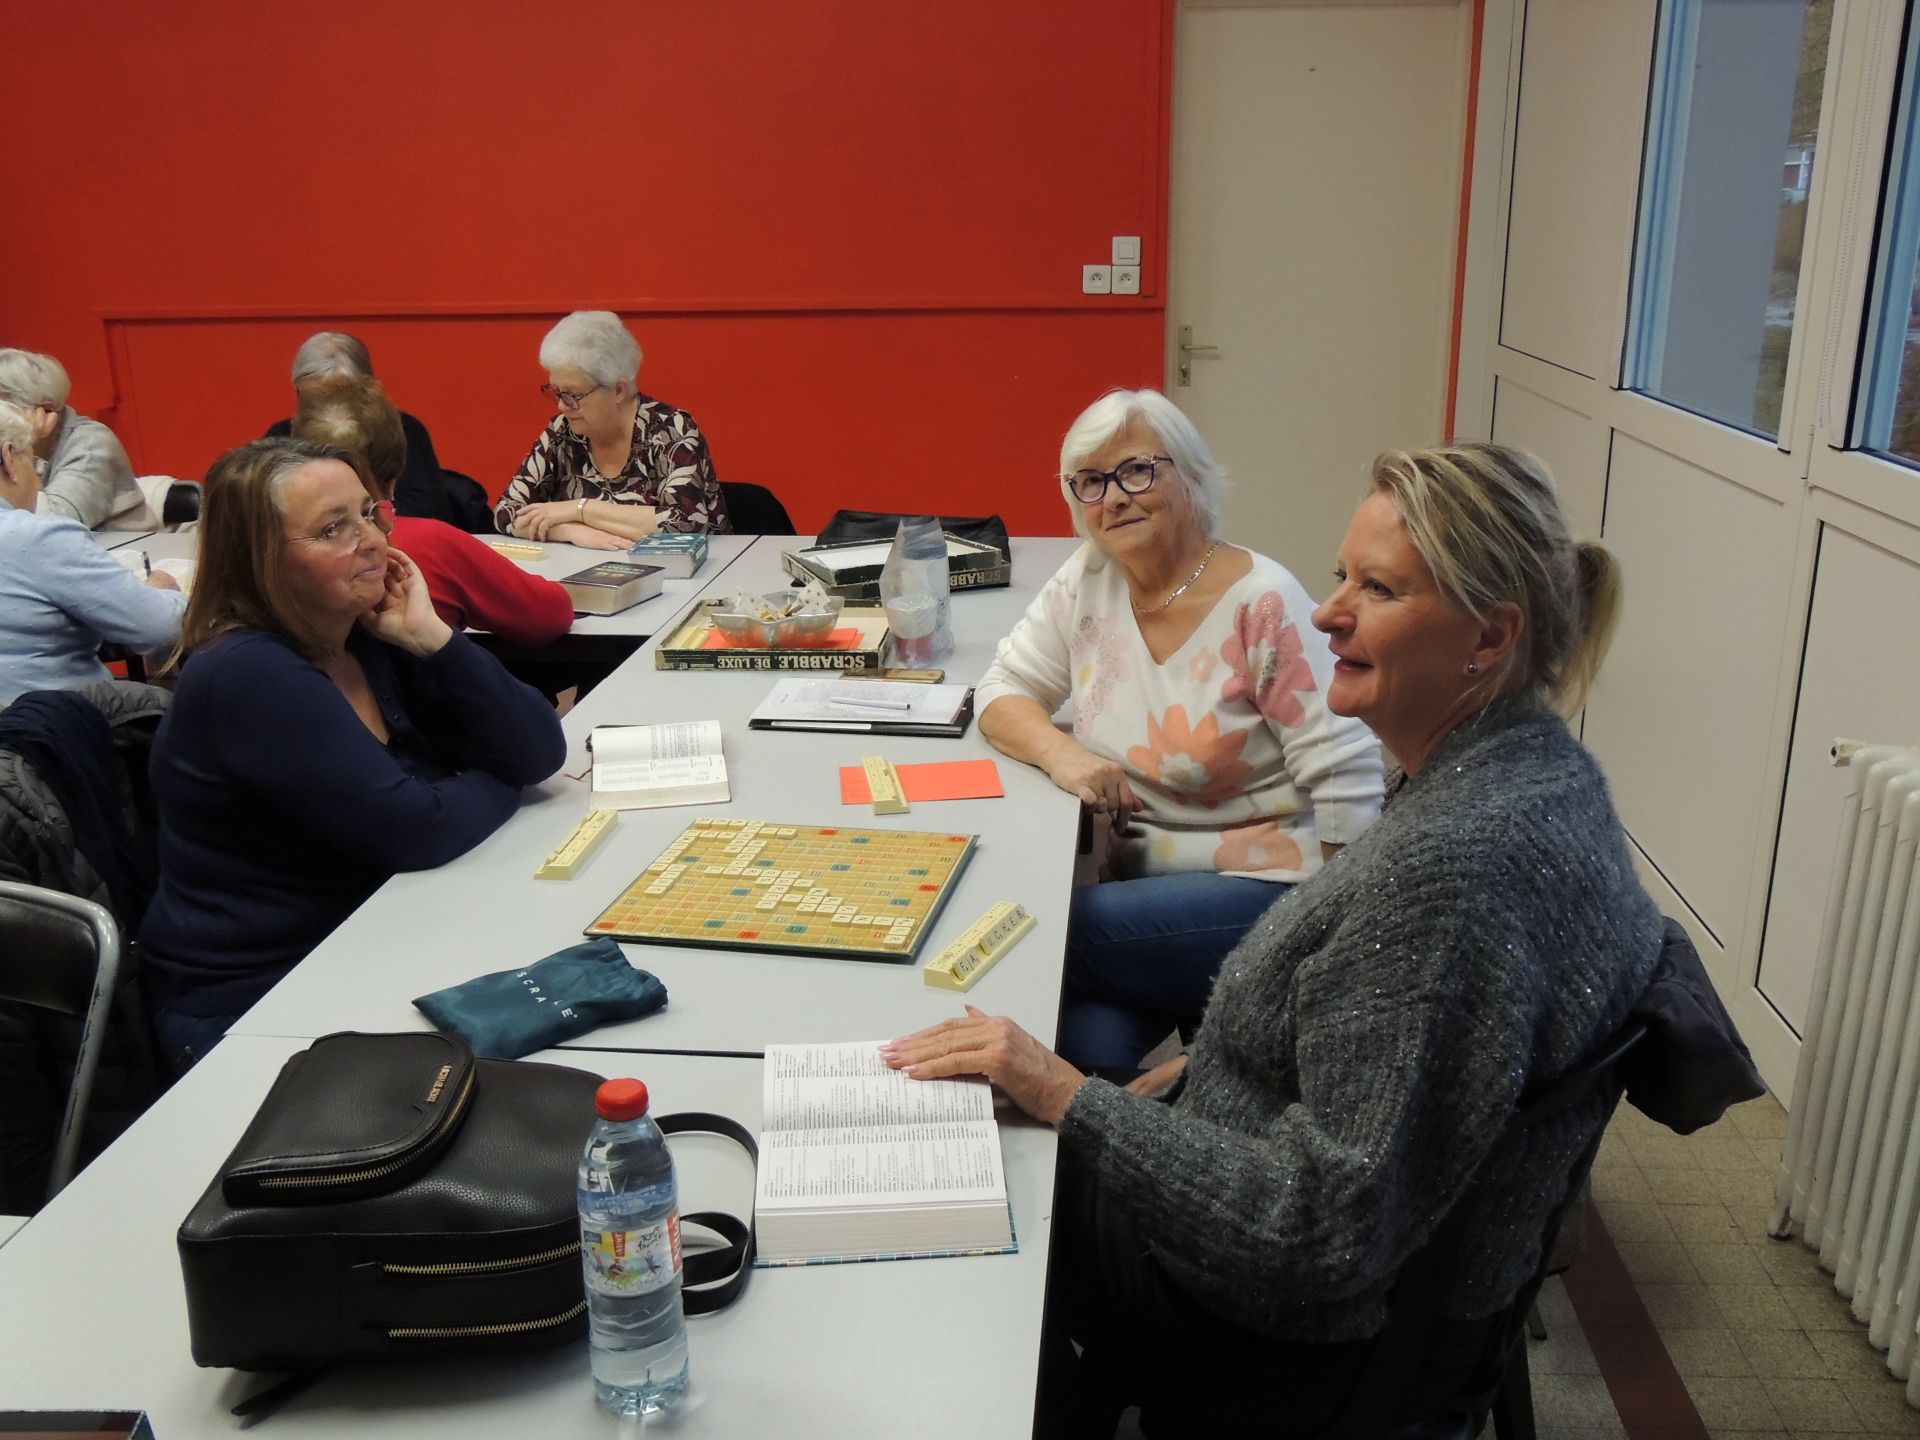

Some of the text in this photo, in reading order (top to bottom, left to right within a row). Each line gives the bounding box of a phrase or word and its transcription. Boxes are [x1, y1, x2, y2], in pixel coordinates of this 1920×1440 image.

[949, 570, 1001, 587] SCRABB
[717, 657, 750, 669] LUXE
[754, 657, 771, 669] DE
[778, 654, 865, 669] SCRABBLE
